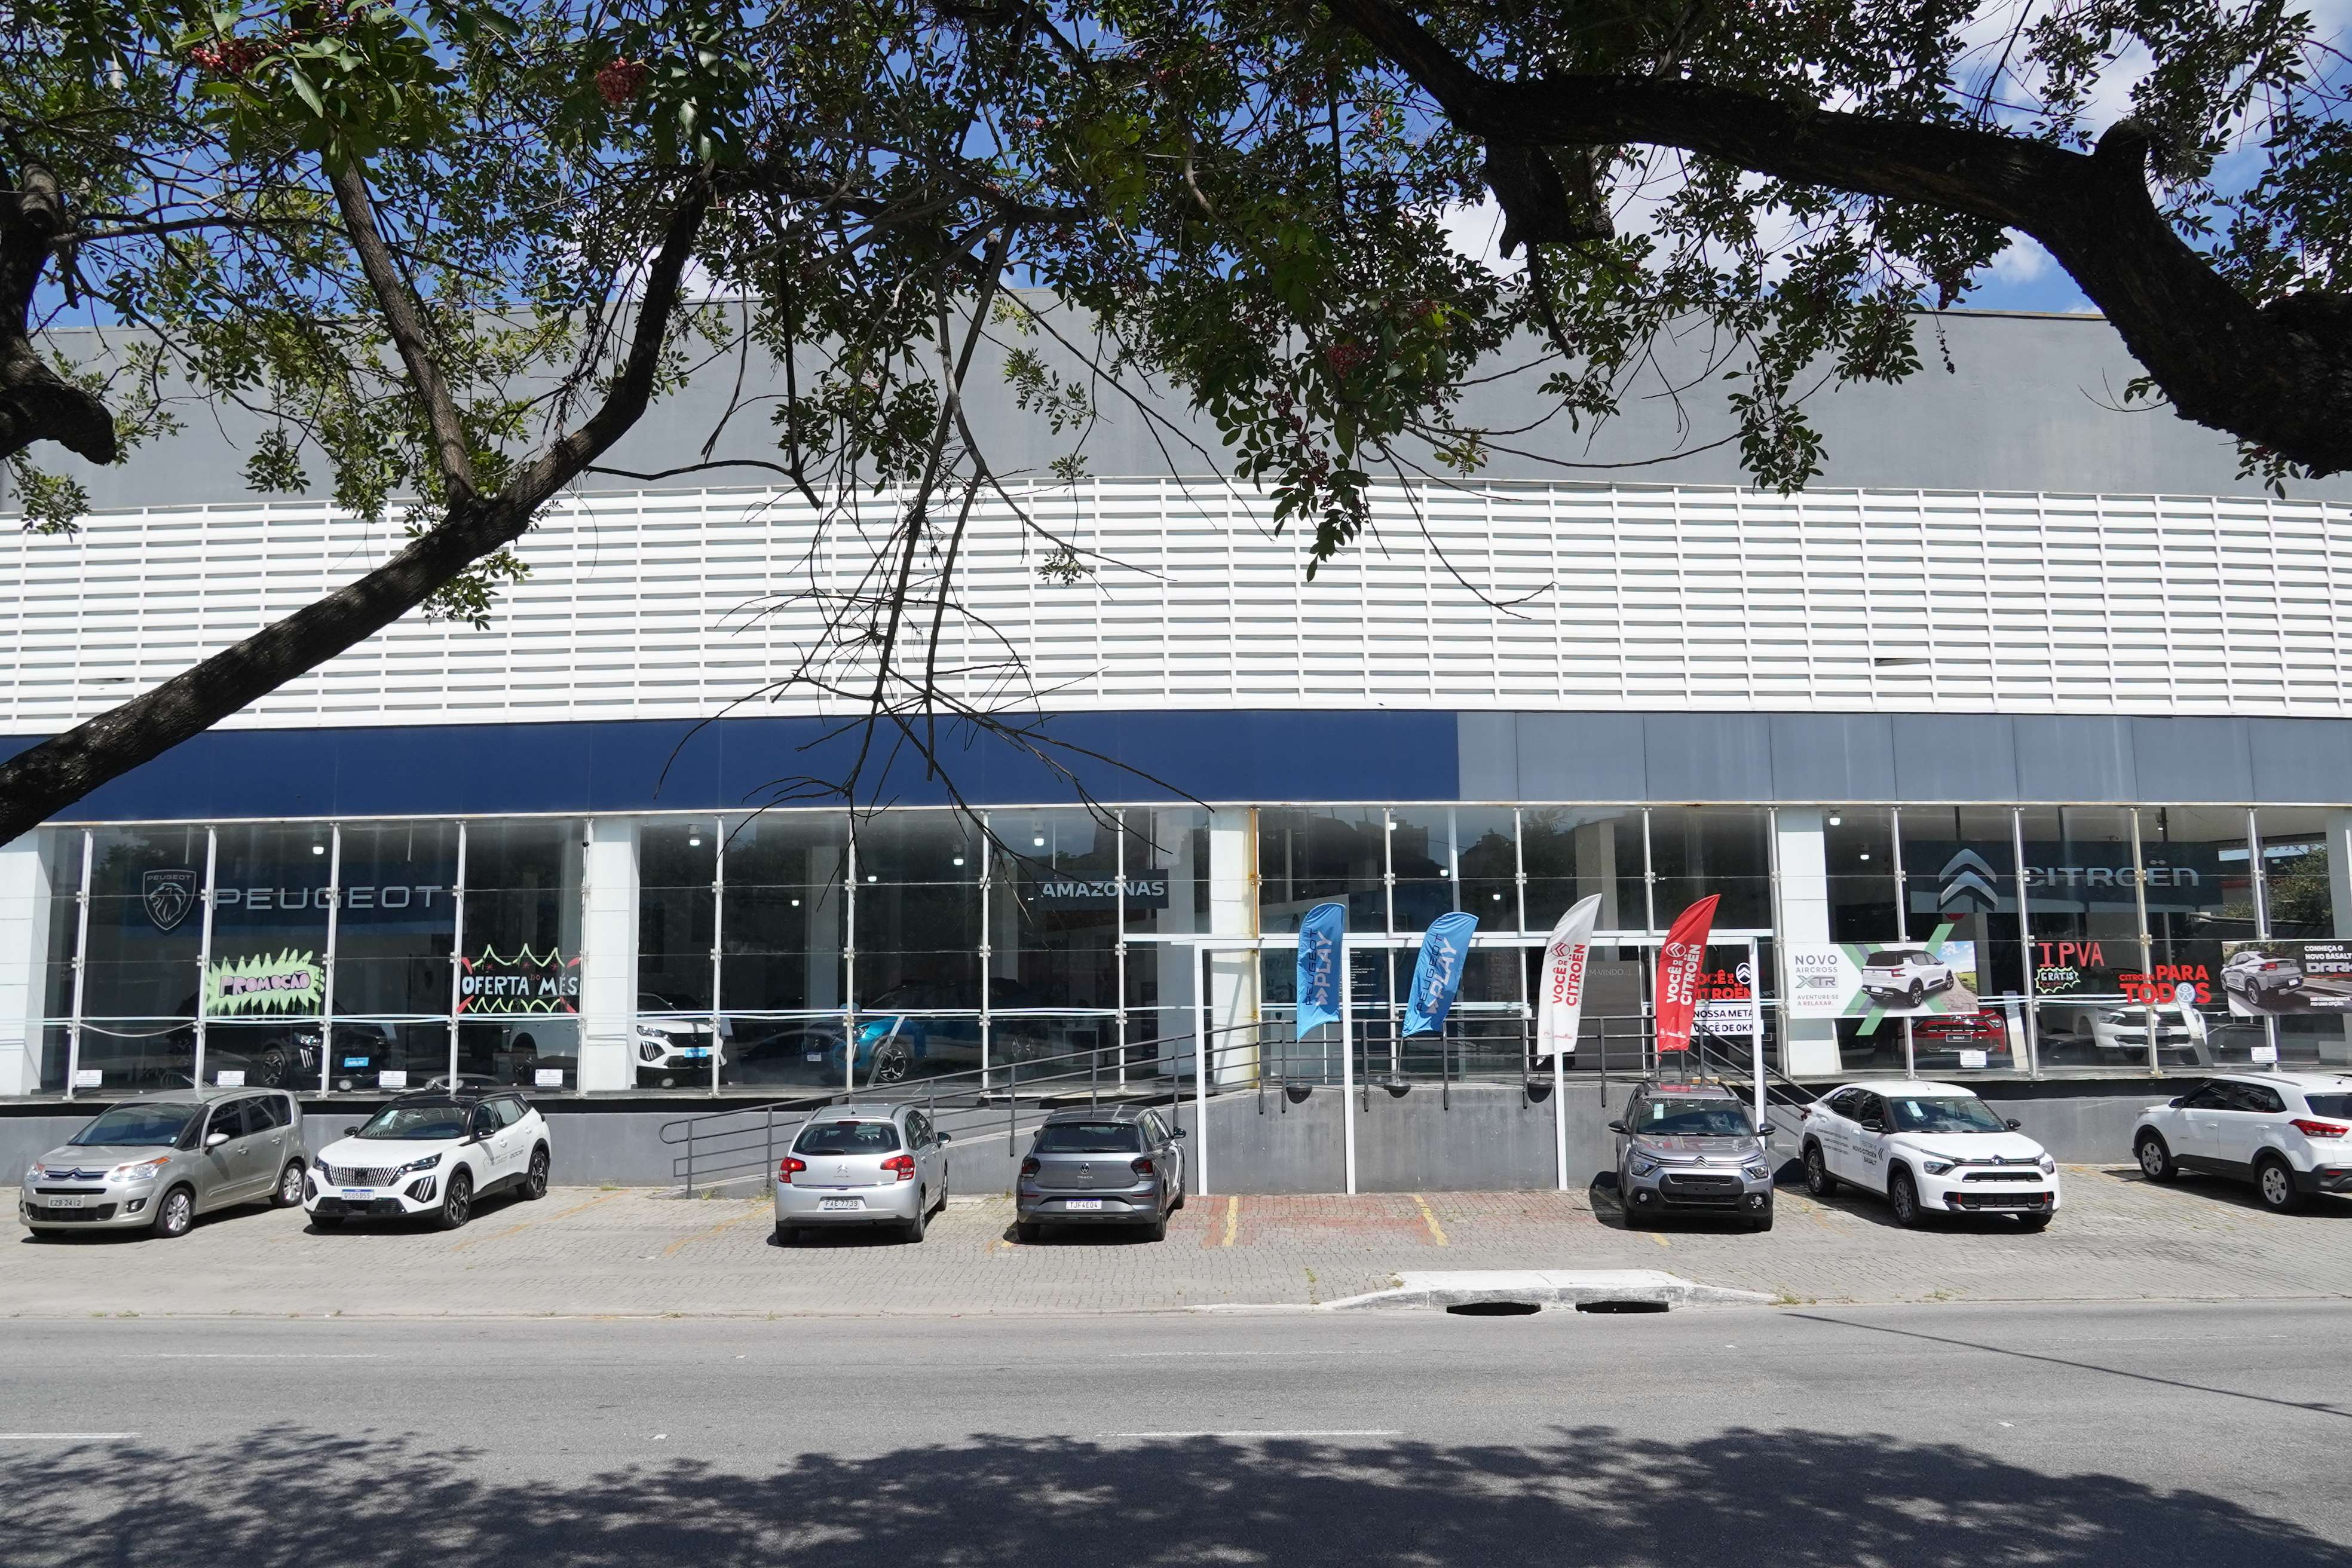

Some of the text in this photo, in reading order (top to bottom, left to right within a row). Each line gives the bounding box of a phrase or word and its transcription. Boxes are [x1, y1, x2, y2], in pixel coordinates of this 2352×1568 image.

[2024, 860, 2200, 887] CITROËN
[213, 885, 443, 910] PEUGEOT
[1042, 881, 1165, 898] AMAZONAS
[1305, 929, 1317, 1006] PEUGEOT
[1315, 931, 1333, 987] PLAY
[1430, 937, 1457, 999] PLAY
[1795, 954, 1838, 965] NOVO
[2038, 942, 2104, 967] IPVA
[219, 969, 311, 998] PROMOÇÃO
[461, 976, 530, 996] OFERTA
[1416, 933, 1443, 1012] PEUGEOT
[1552, 967, 1567, 1004] VOCÊ
[1566, 944, 1585, 1006] CITROËN
[1667, 966, 1683, 1003] VOCÊ
[1680, 944, 1702, 1006] CITROËN
[1696, 969, 1726, 985] OCÊ
[1794, 975, 1837, 988] XTR
[2155, 964, 2209, 981] PARA
